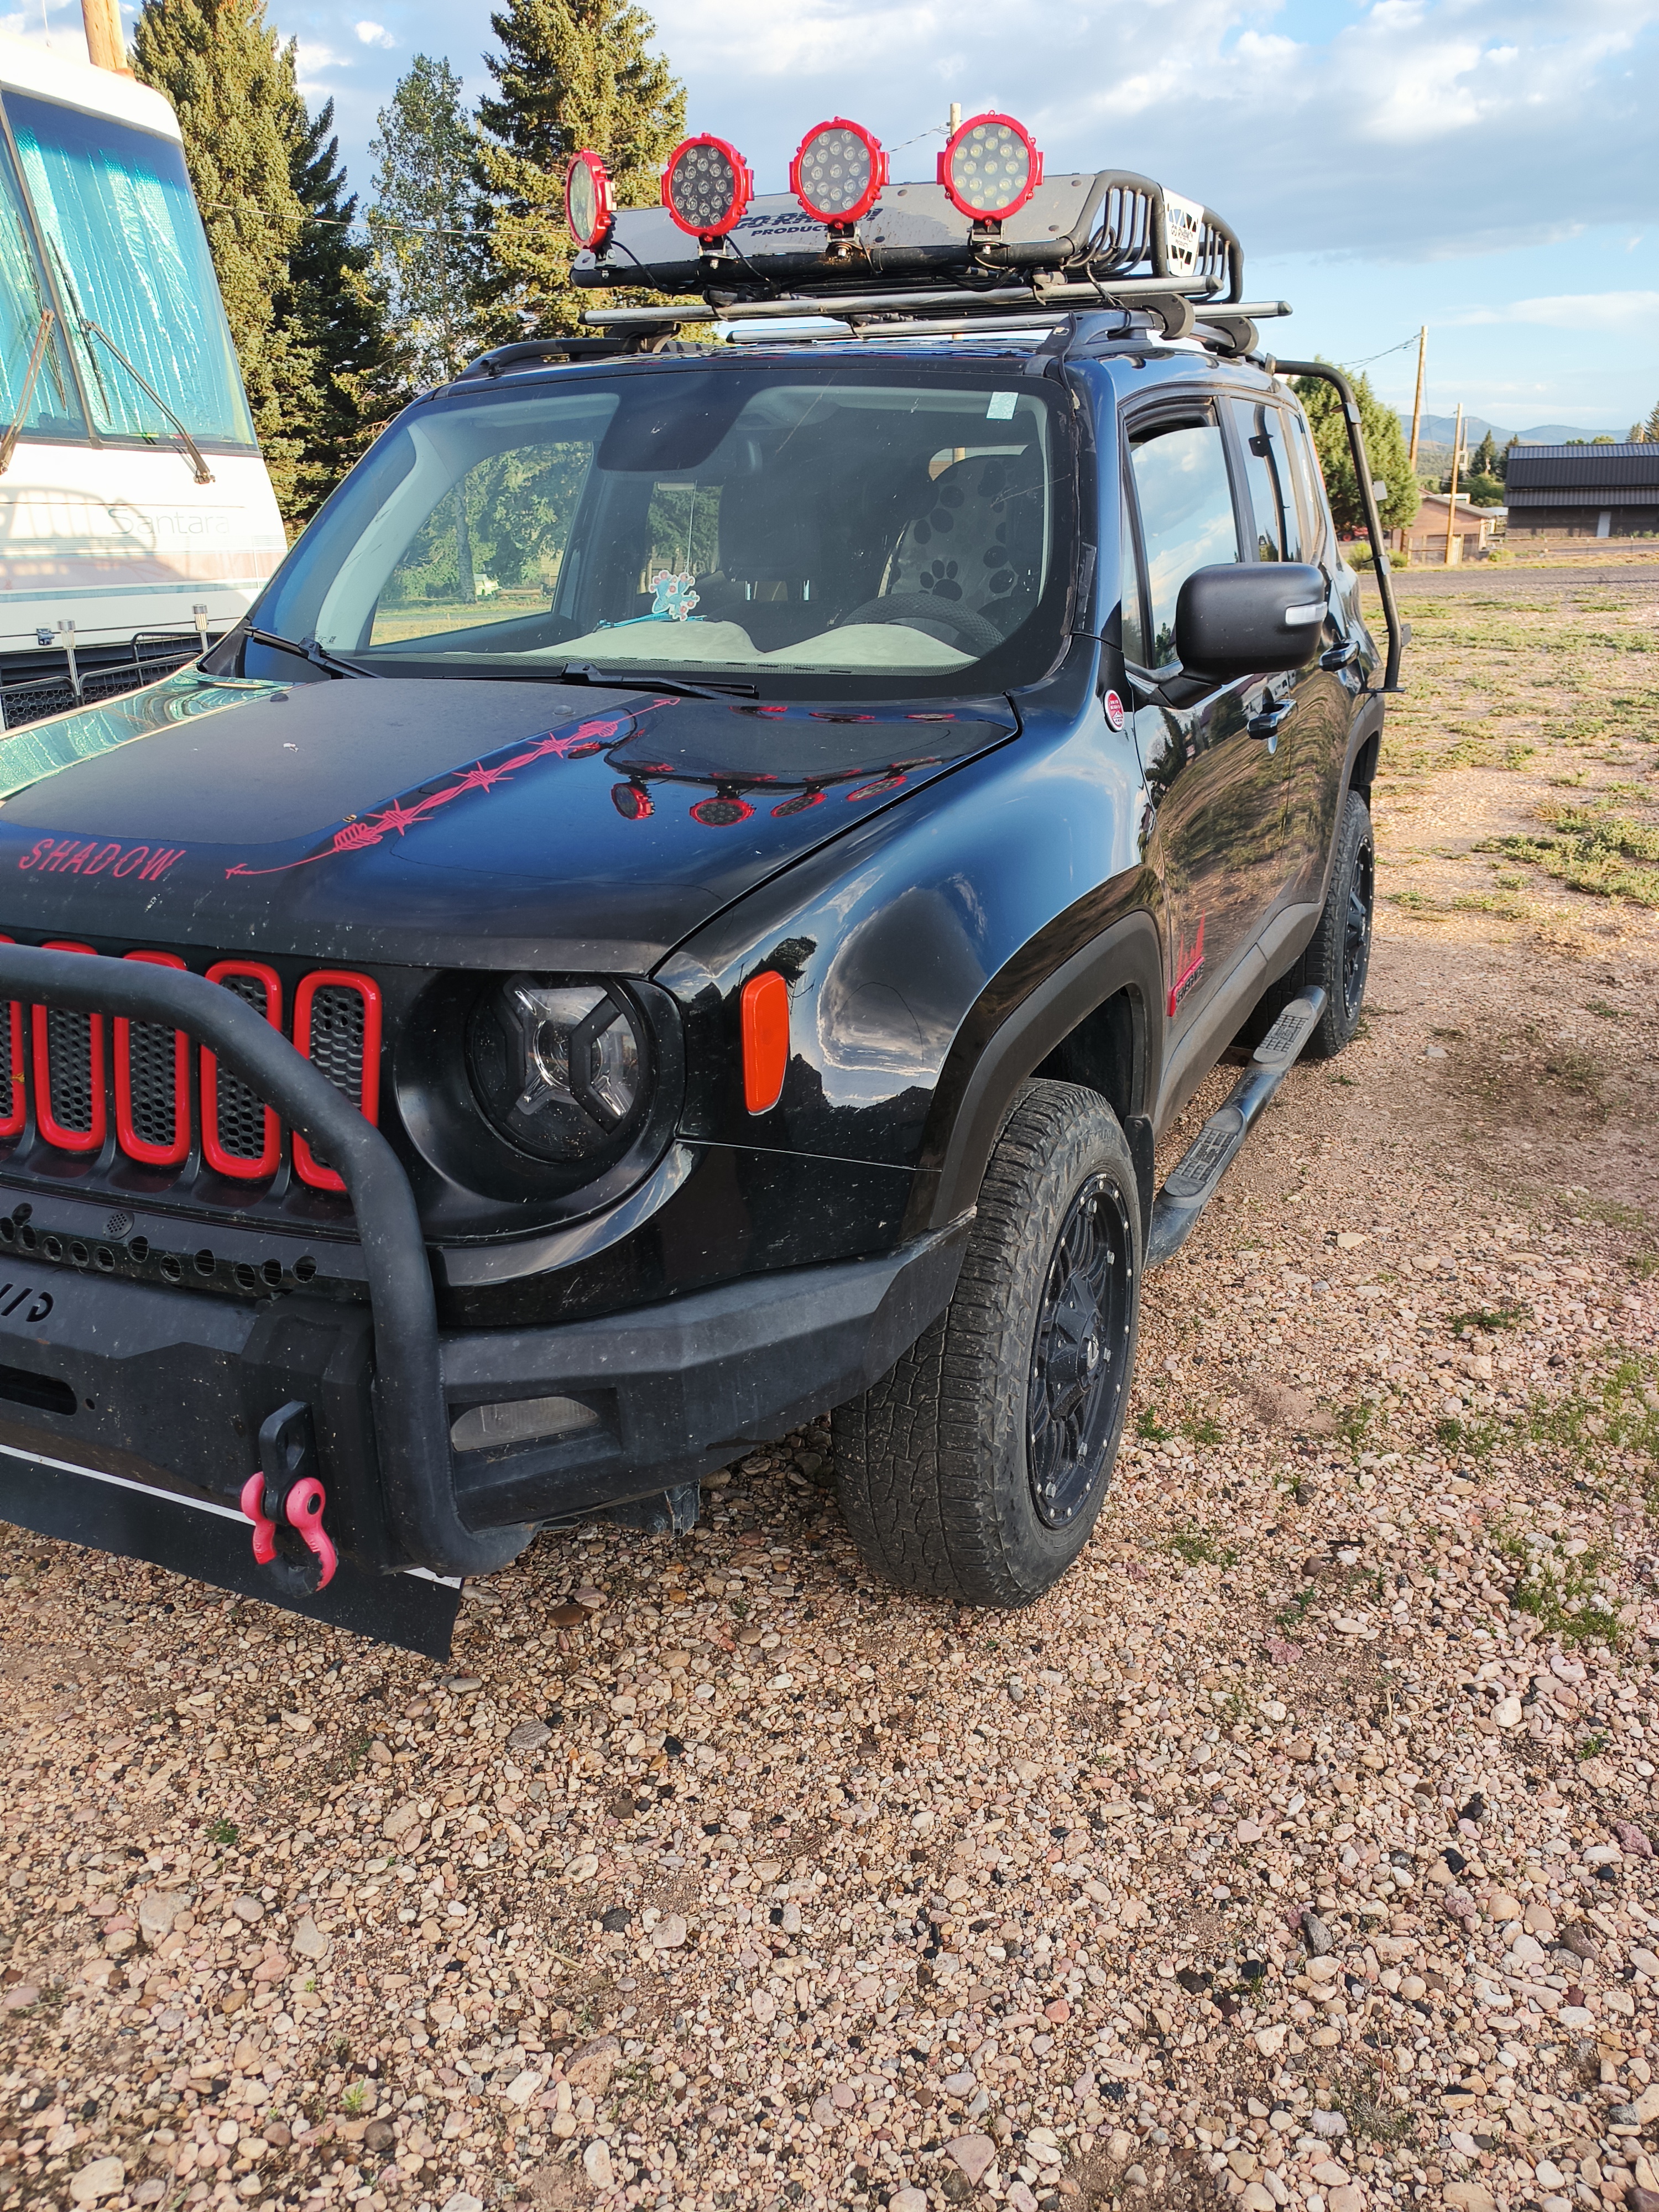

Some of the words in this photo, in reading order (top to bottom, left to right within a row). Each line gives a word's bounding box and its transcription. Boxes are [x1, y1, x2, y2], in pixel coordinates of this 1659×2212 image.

[751, 225, 828, 237] PRODUCT
[108, 508, 229, 534] Santara
[18, 838, 187, 881] SHADOW
